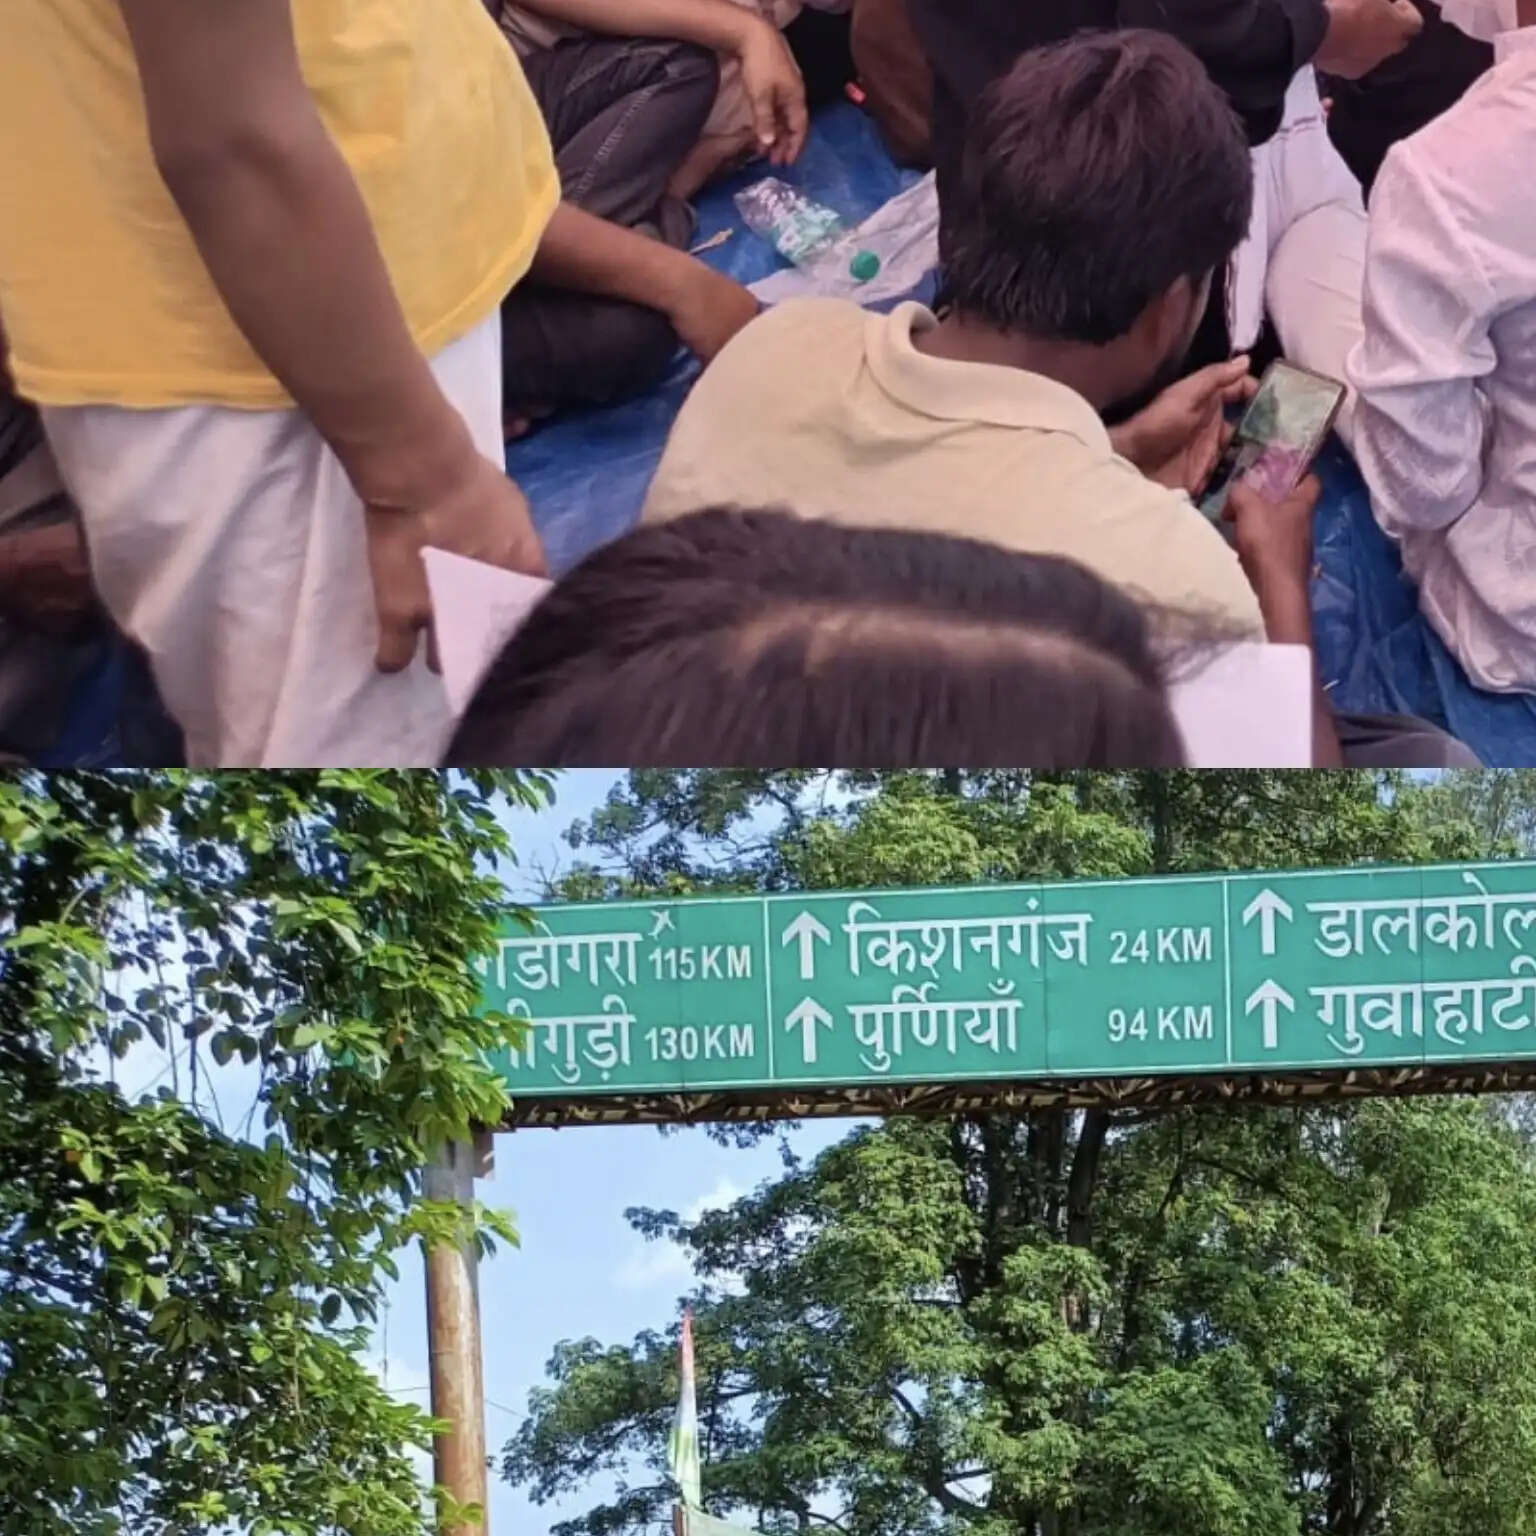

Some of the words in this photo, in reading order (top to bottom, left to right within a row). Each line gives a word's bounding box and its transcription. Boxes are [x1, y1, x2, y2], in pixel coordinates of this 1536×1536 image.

[473, 920, 644, 990] गडोगरा
[649, 947, 695, 980] 115
[702, 944, 751, 978] KM
[842, 897, 1092, 978] किशनगंज
[1110, 930, 1150, 964] 24
[1157, 927, 1211, 963] KM
[645, 1026, 699, 1060] 130
[704, 1024, 754, 1058] KM
[1108, 1008, 1148, 1043] 94
[1158, 1006, 1213, 1040] KM
